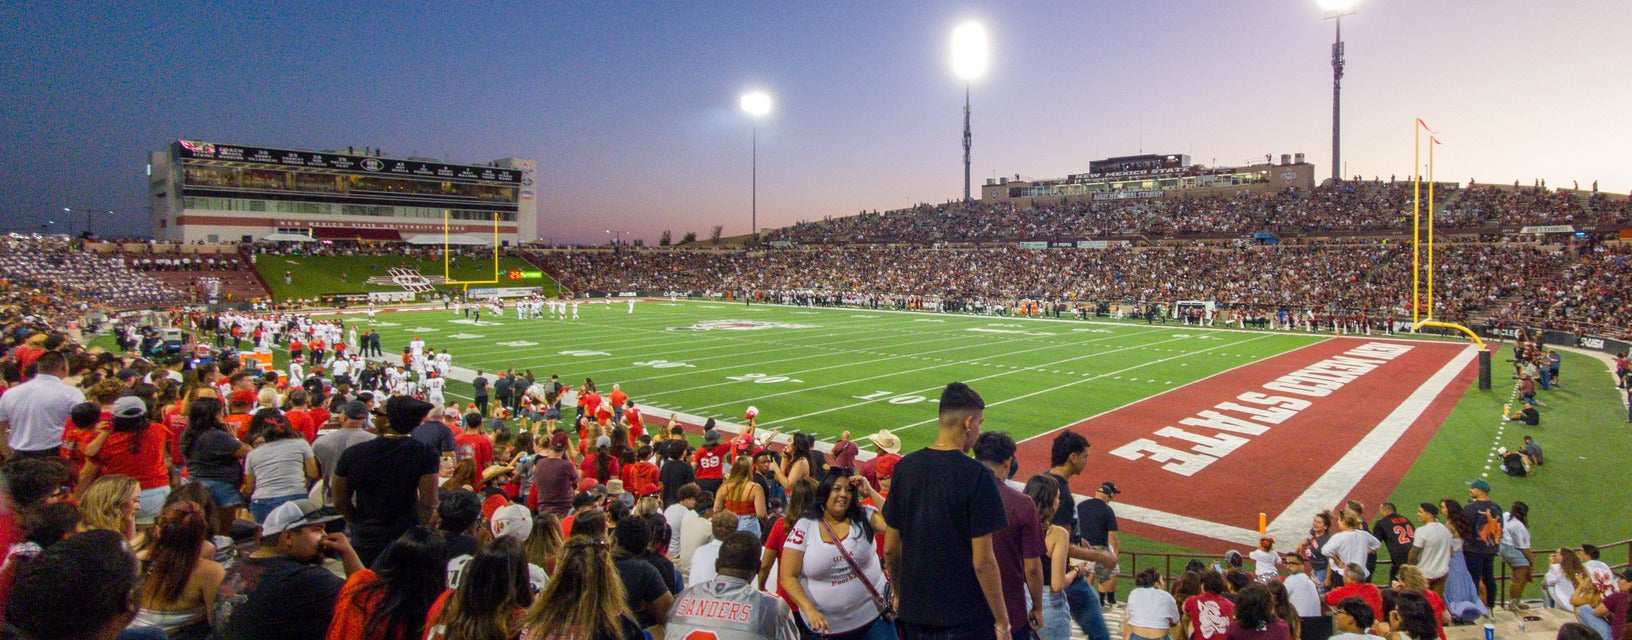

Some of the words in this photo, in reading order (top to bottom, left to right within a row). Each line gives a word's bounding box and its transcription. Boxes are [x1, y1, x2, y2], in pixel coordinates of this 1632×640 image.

[1105, 169, 1148, 177] MEXICO
[1151, 167, 1191, 175] STATE
[1137, 190, 1164, 199] STADIUM
[1342, 341, 1416, 361] NEW
[1262, 354, 1388, 398] MEXICO
[851, 390, 927, 405] 10
[1108, 390, 1313, 478] STATE
[676, 597, 753, 623] SANDERS
